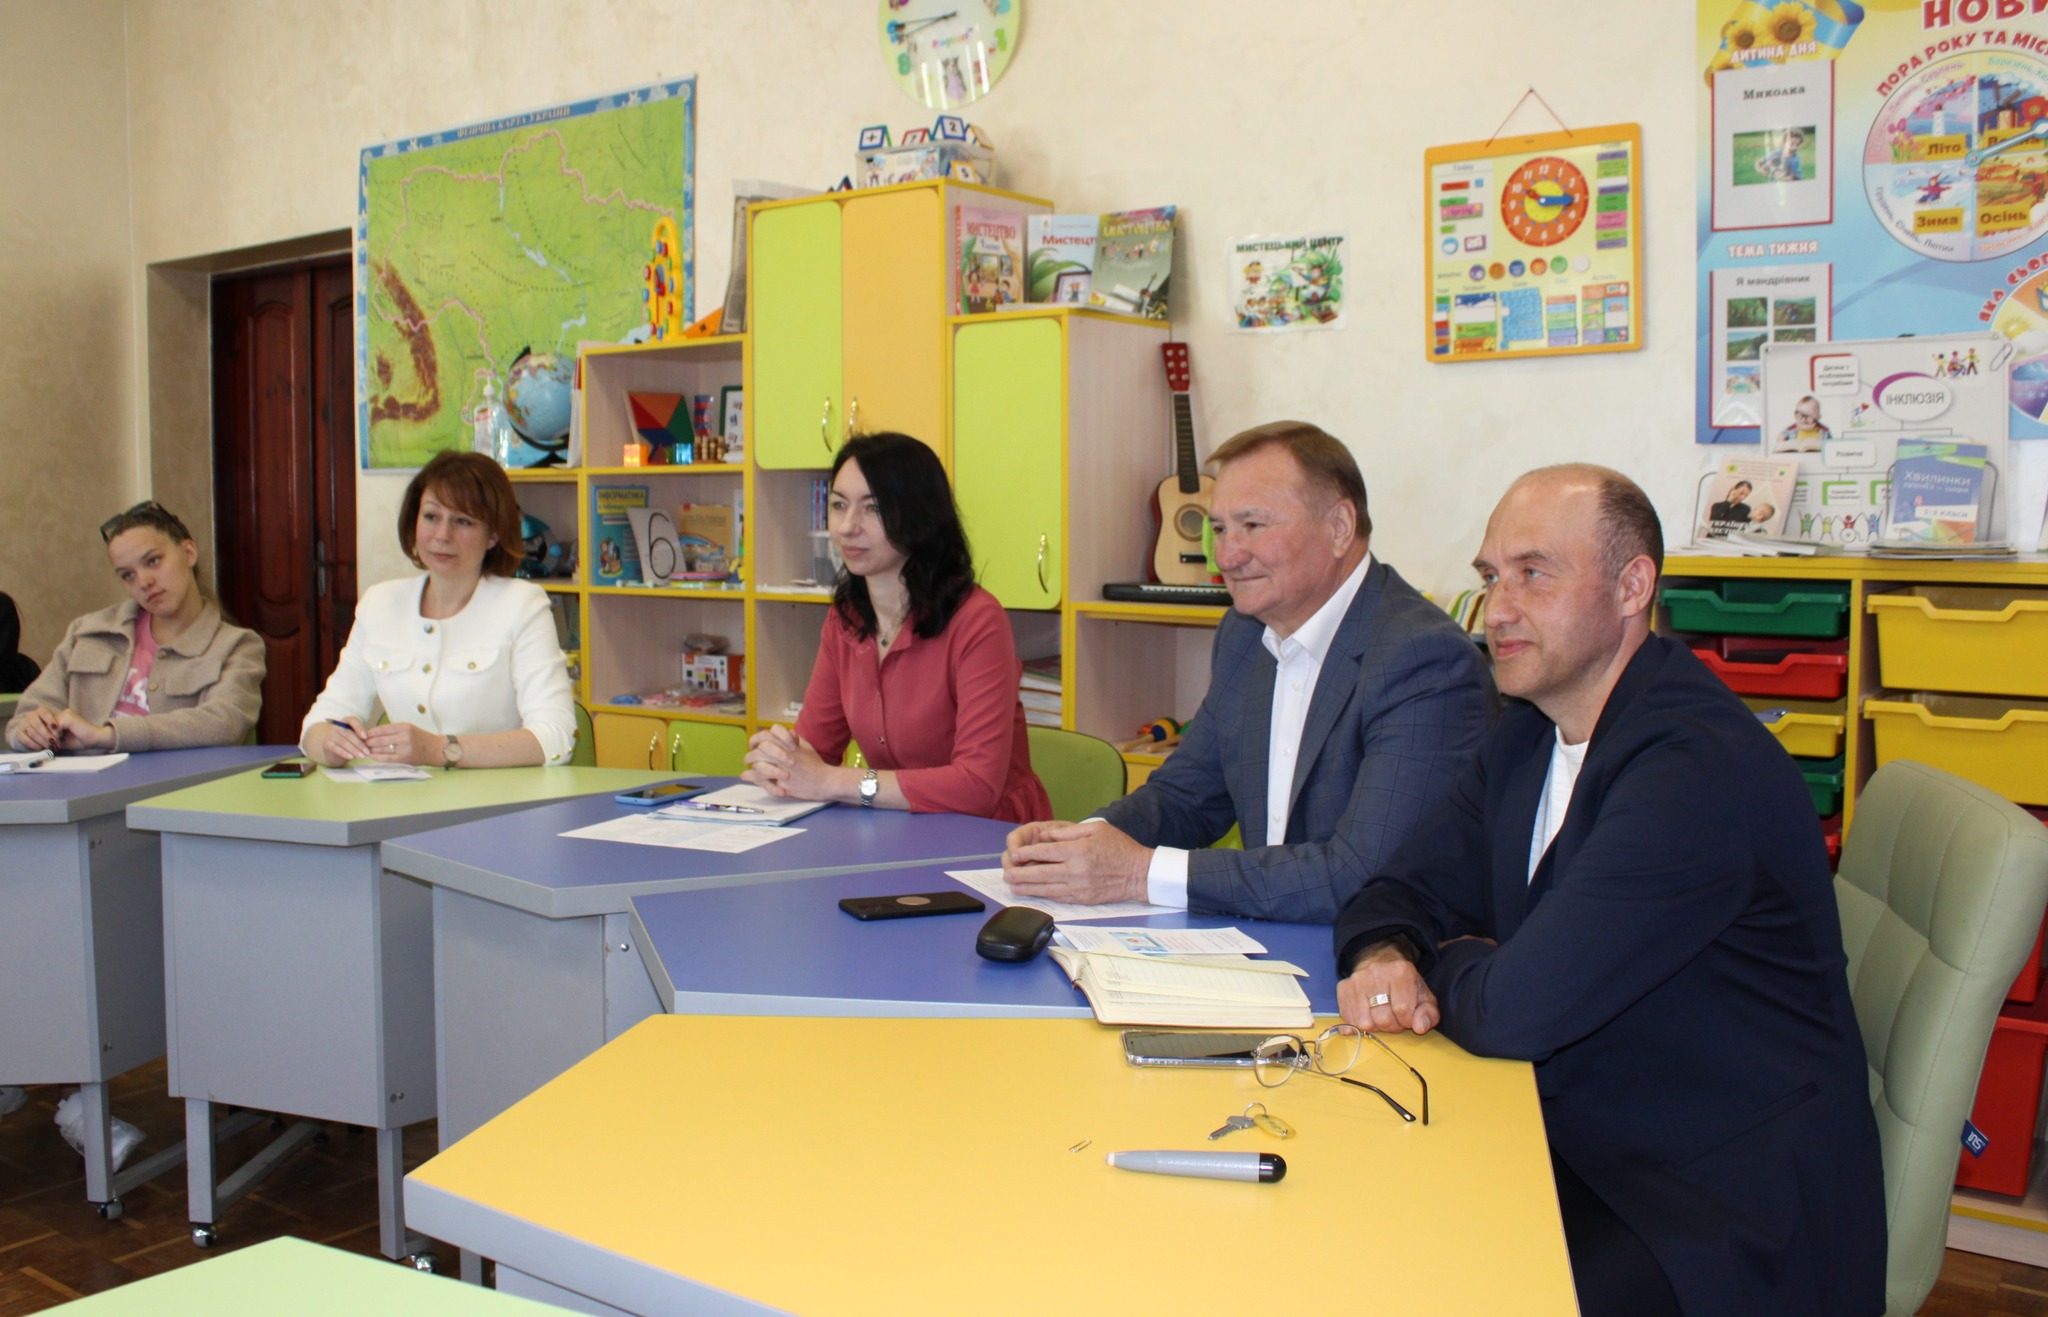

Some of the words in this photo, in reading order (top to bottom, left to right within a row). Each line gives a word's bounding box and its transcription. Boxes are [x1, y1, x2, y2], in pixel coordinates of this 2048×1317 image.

[1730, 44, 1785, 64] ДИТИНА
[1789, 40, 1818, 57] ДНЯ
[897, 52, 911, 75] 8
[1876, 55, 1923, 97] ПОРА
[1924, 32, 1976, 60] РОКУ
[1982, 31, 2007, 45] ТА
[1743, 86, 1806, 101] Миколка
[949, 121, 957, 132] 2
[1928, 143, 1961, 155] Літо
[1538, 164, 1550, 175] 12
[1511, 183, 1522, 193] 10
[1916, 215, 1959, 229] Зима
[1979, 210, 2028, 225] Осінь
[966, 221, 1016, 241] МИСТЕЦТВО
[1236, 238, 1307, 252] МИСТЕЦЬКИЙ
[1309, 236, 1344, 248] ЦЕНТР
[1728, 243, 1765, 258] ТЕМА
[1768, 240, 1818, 255] ТИЖНЯ
[1736, 277, 1744, 286] Я
[1747, 275, 1811, 287] мандрівник
[1978, 289, 2005, 322] ЯКА
[1886, 392, 1945, 406] ІНКЛЮЗІЯ
[648, 512, 675, 579] 6
